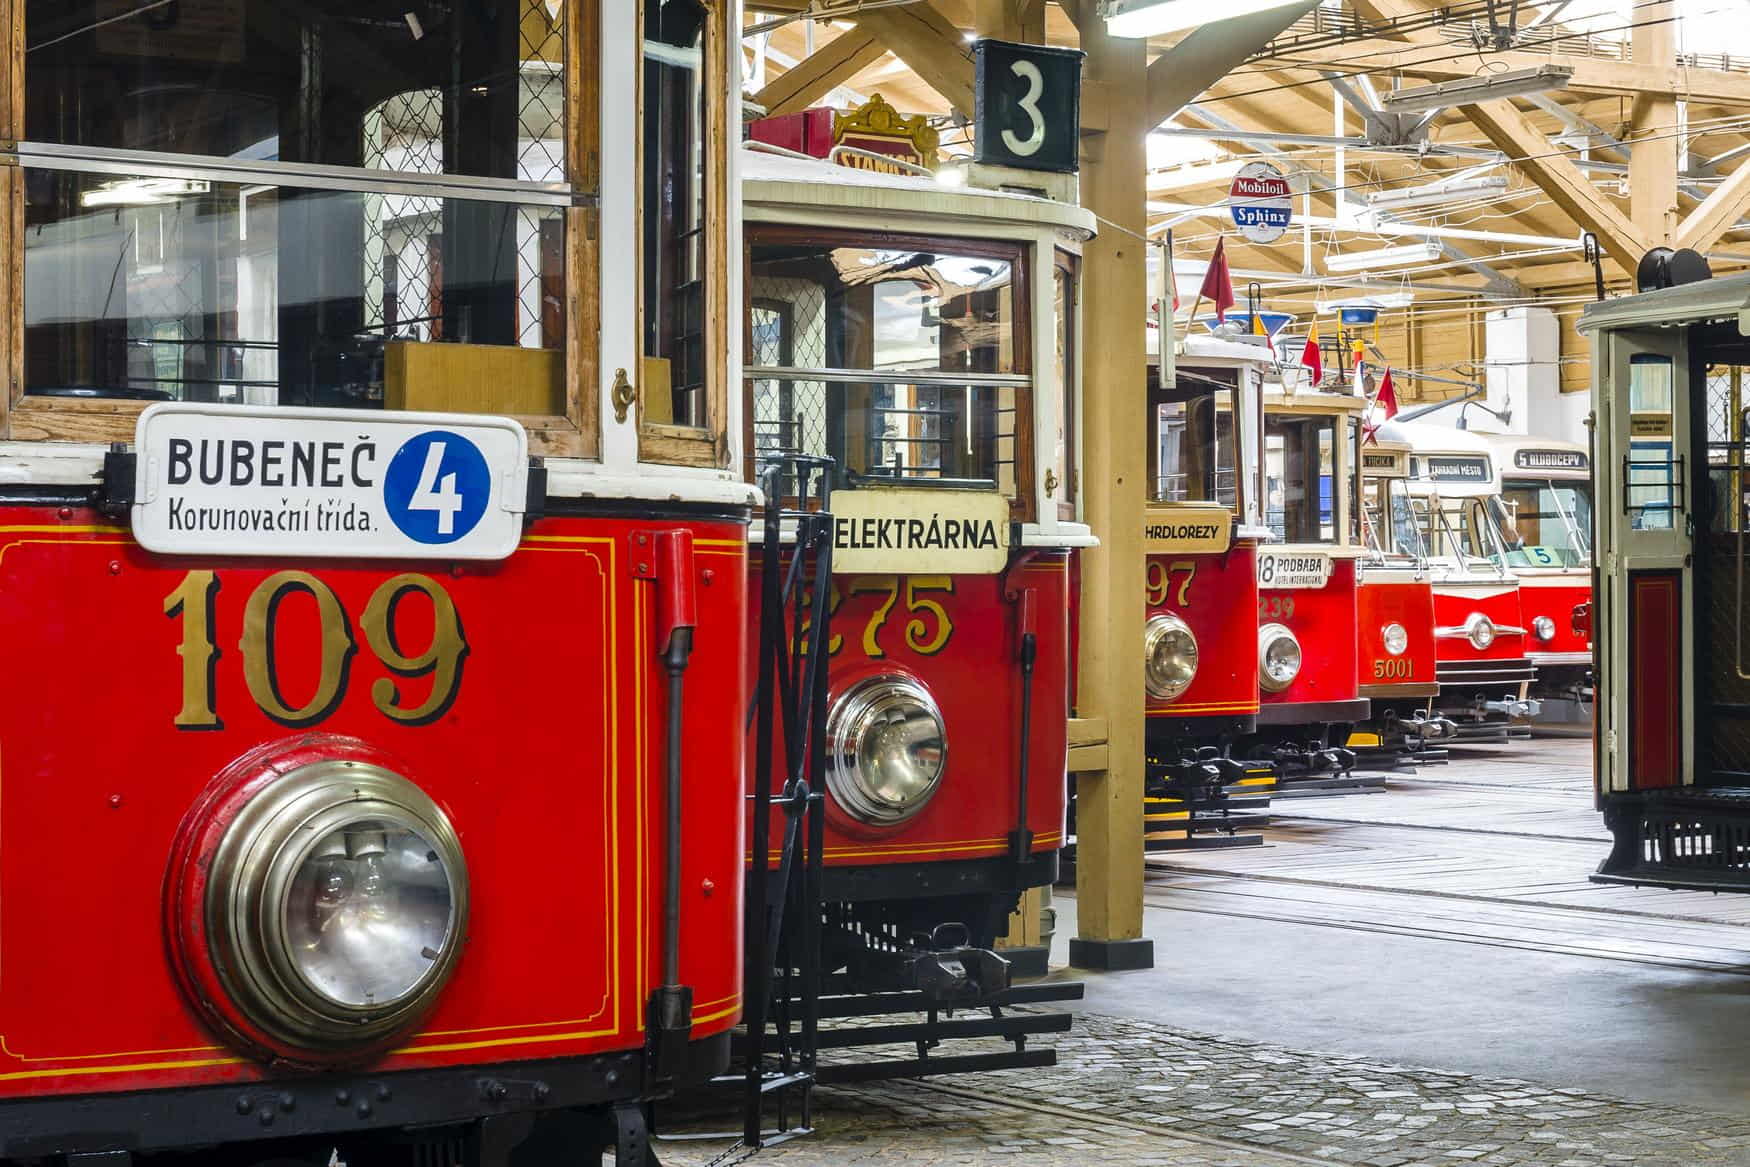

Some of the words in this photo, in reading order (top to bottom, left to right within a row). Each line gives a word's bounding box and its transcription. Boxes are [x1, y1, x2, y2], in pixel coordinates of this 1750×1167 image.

[1001, 60, 1045, 156] 3
[1238, 180, 1284, 195] Mobiloil
[1238, 207, 1286, 225] Sphinx
[168, 435, 376, 488] BUBENEČ
[1519, 452, 1527, 466] 5
[408, 441, 463, 534] 4
[169, 497, 309, 531] Korunovační
[317, 498, 378, 532] třída.
[834, 513, 998, 549] ELEKTRÁRNA
[1258, 555, 1275, 582] 18
[1277, 558, 1322, 573] PODBABA
[1534, 548, 1551, 564] 5
[163, 569, 470, 731] 109
[1375, 658, 1413, 678] 5001
